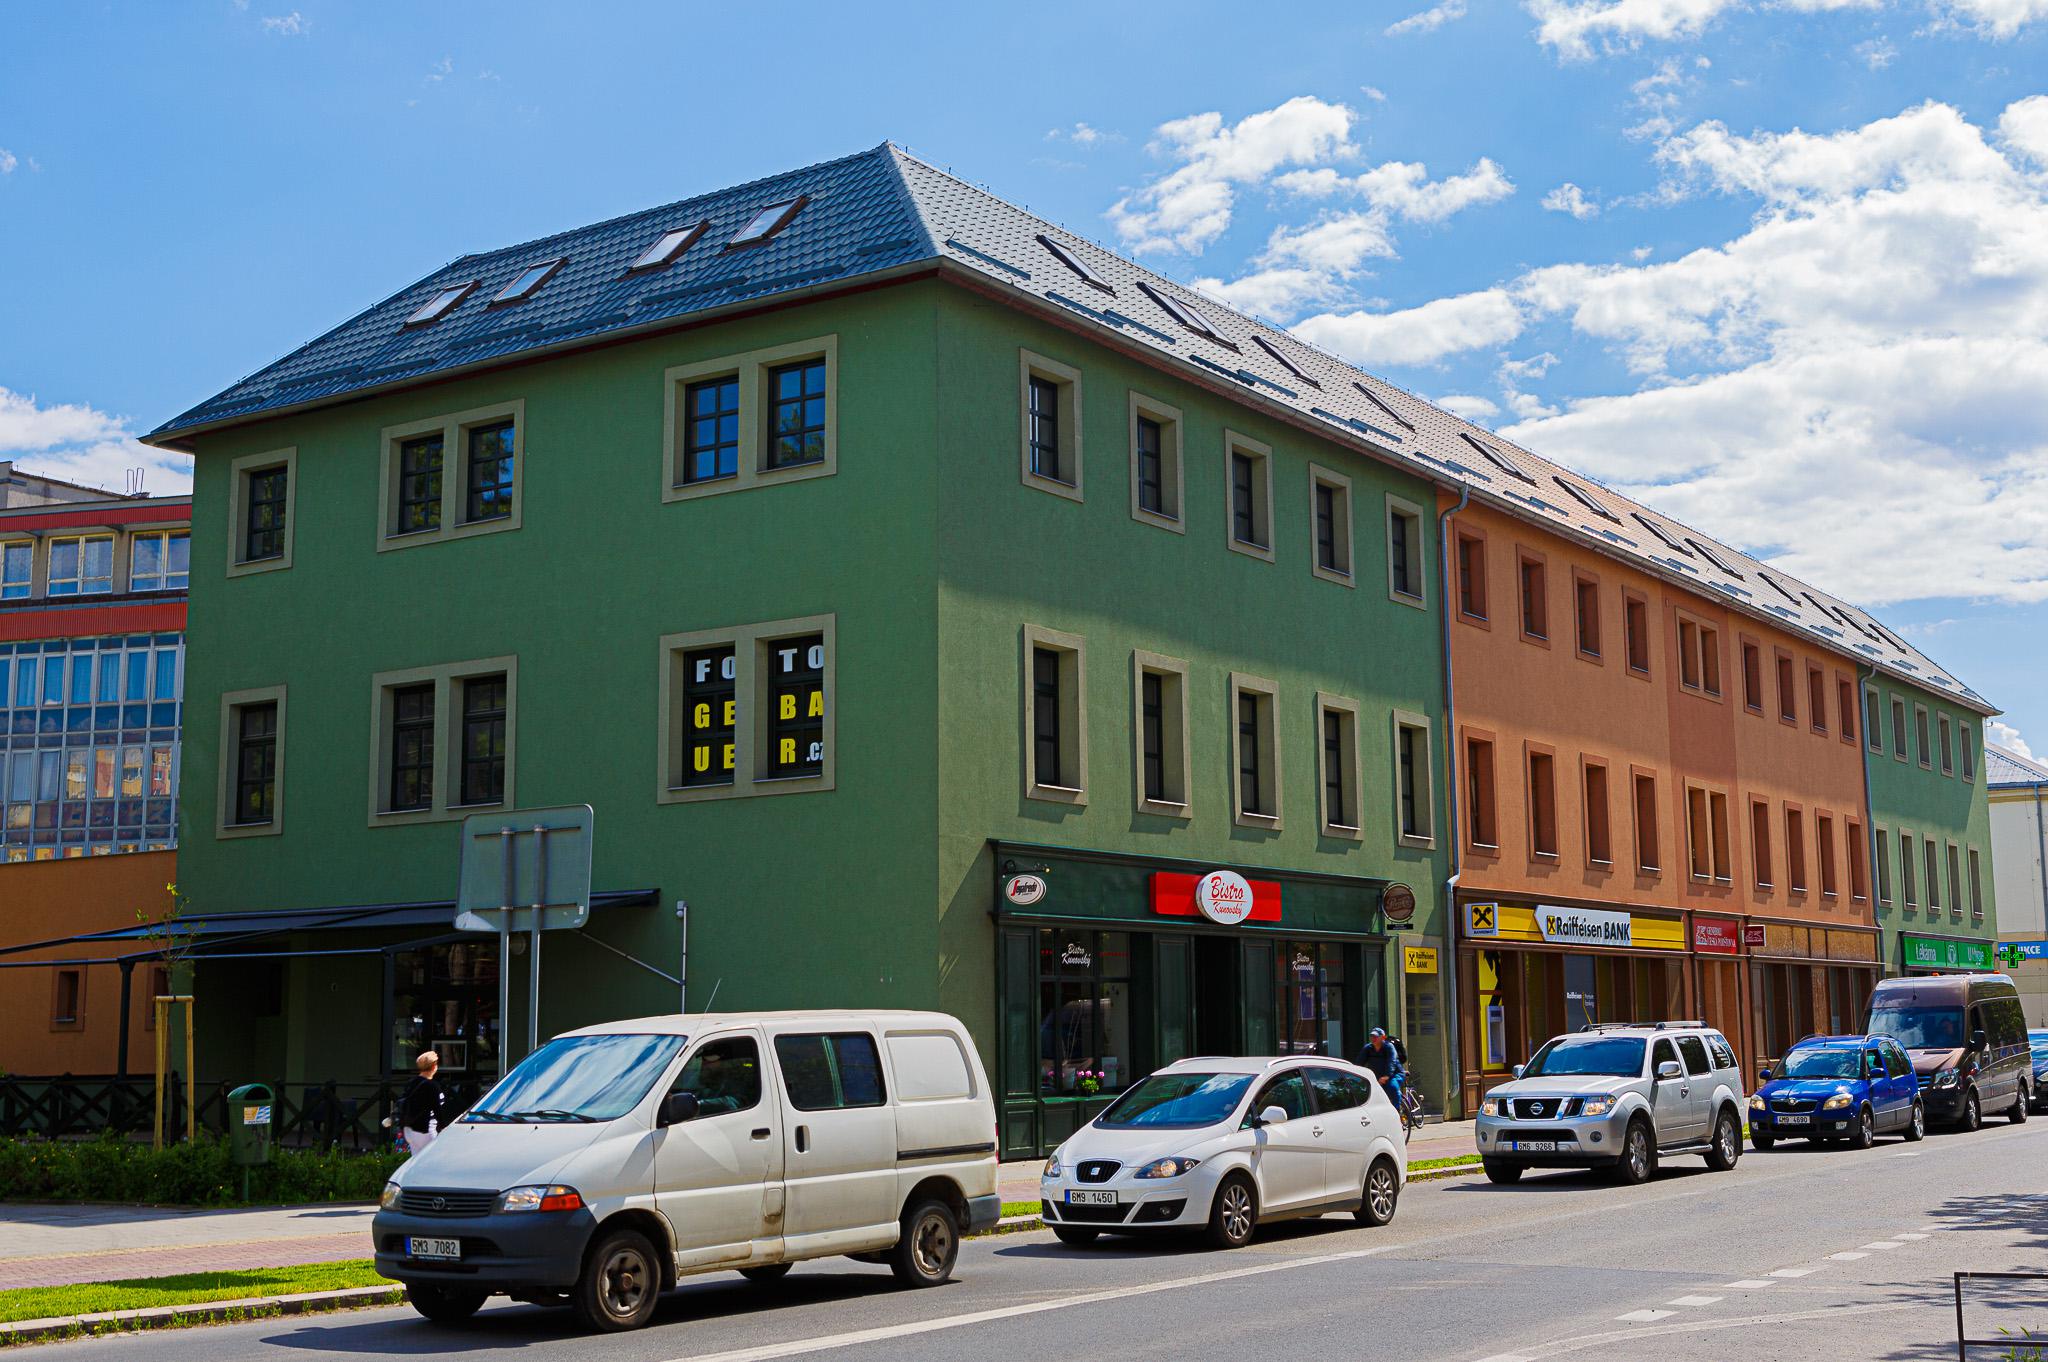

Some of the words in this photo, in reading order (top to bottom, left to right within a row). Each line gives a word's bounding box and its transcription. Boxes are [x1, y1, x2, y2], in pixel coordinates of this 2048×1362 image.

[1210, 876, 1244, 899] Bistro
[1556, 915, 1602, 939] Raiffeisen
[1604, 921, 1630, 941] BANK
[1068, 943, 1085, 954] Bistro
[1416, 951, 1435, 960] Raiffeisen
[1416, 961, 1428, 969] BANK
[1071, 1192, 1086, 1203] 6M9
[1092, 1192, 1112, 1203] 1450
[412, 1239, 428, 1253] 5M3
[434, 1240, 456, 1255] 7082
